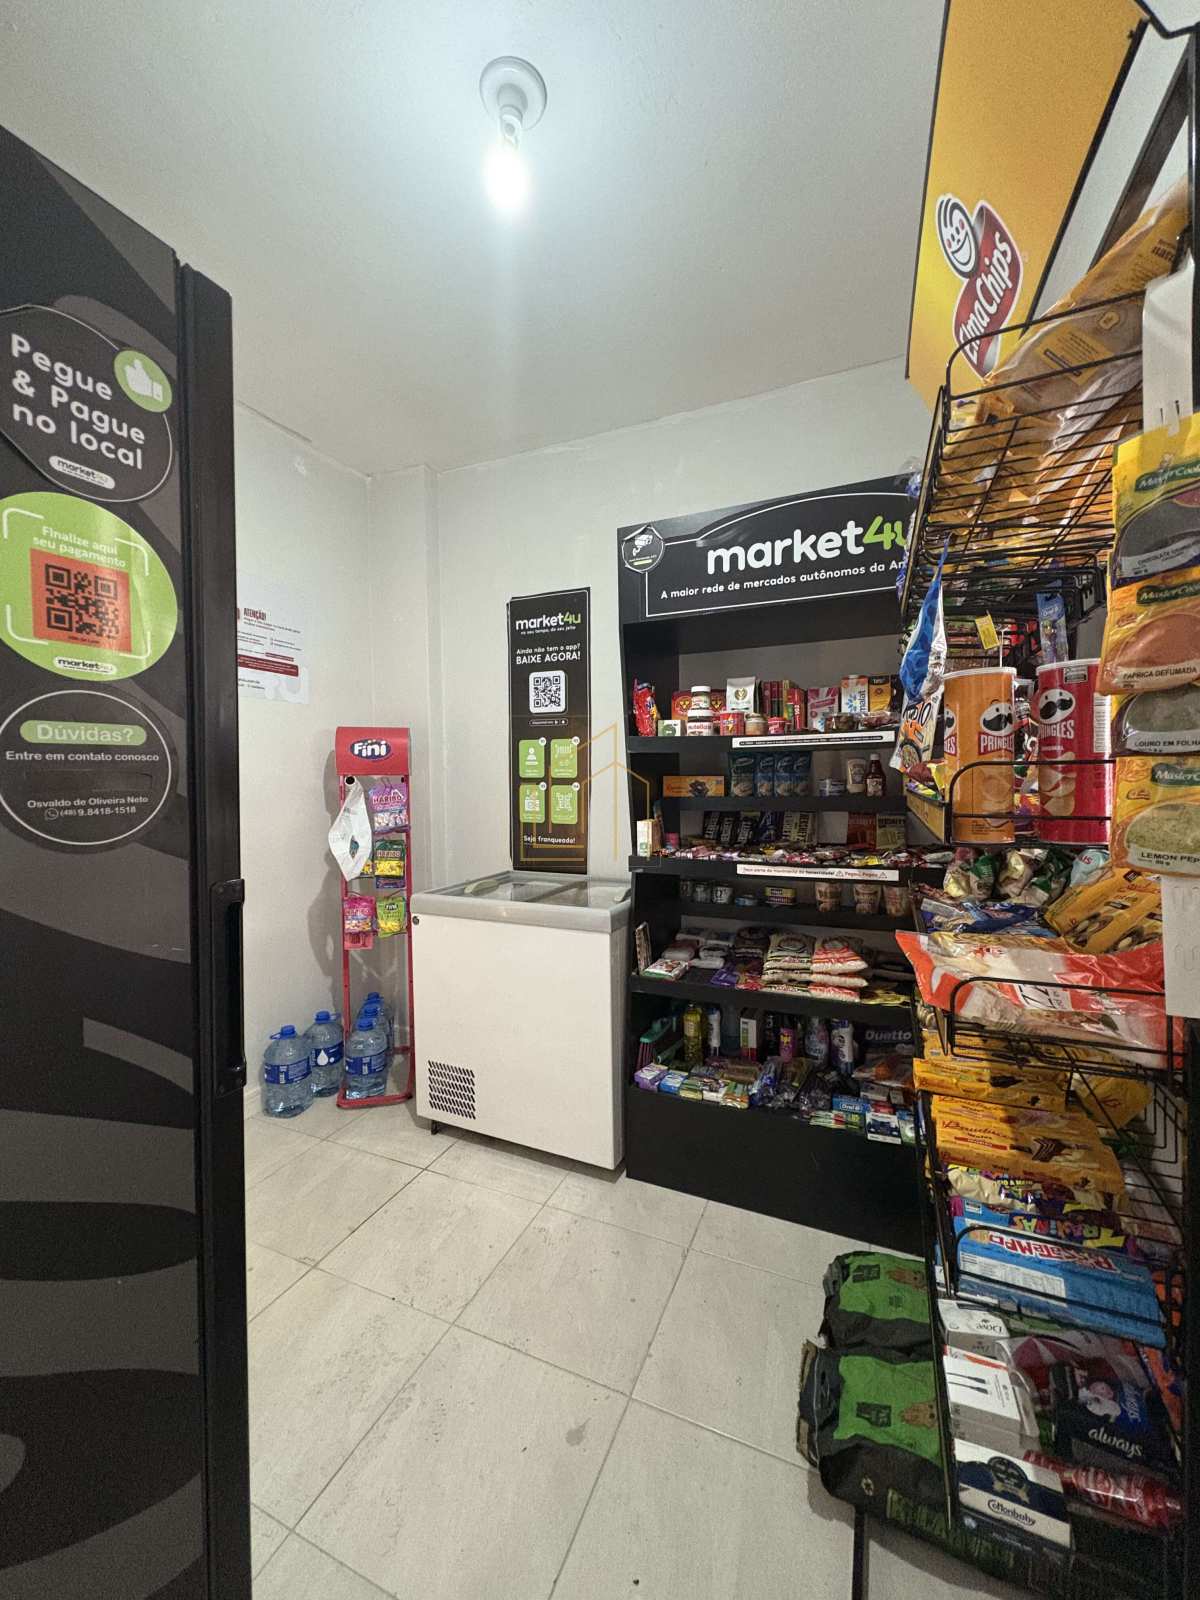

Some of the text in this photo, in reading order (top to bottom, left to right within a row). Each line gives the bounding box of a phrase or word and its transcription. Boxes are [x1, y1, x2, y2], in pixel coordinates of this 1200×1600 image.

[11, 333, 112, 400] Pegue
[12, 369, 145, 445] & Pague
[13, 403, 142, 469] no local
[33, 537, 126, 568] seu pagamento
[92, 543, 118, 556] aqui
[660, 590, 668, 599] A
[670, 587, 699, 598] maior
[702, 583, 725, 594] rede
[728, 580, 740, 591] de
[743, 575, 796, 590] mercados
[800, 565, 865, 583] autônomos
[870, 562, 885, 573] da
[516, 612, 581, 630] market4u
[516, 647, 532, 655] Ainda
[566, 643, 581, 651] app?
[516, 651, 581, 665] BAIXE AGORA!
[36, 723, 134, 743] Dúvidas?
[354, 743, 387, 758] Fini
[980, 734, 1015, 753] PRINGLE
[6, 751, 160, 762] Entre em contato conosco
[27, 799, 71, 808] Osvaldo
[88, 797, 125, 806] Oliveira
[127, 796, 148, 804] Neto
[1141, 852, 1177, 861] LEMON
[1088, 1426, 1143, 1458] always
